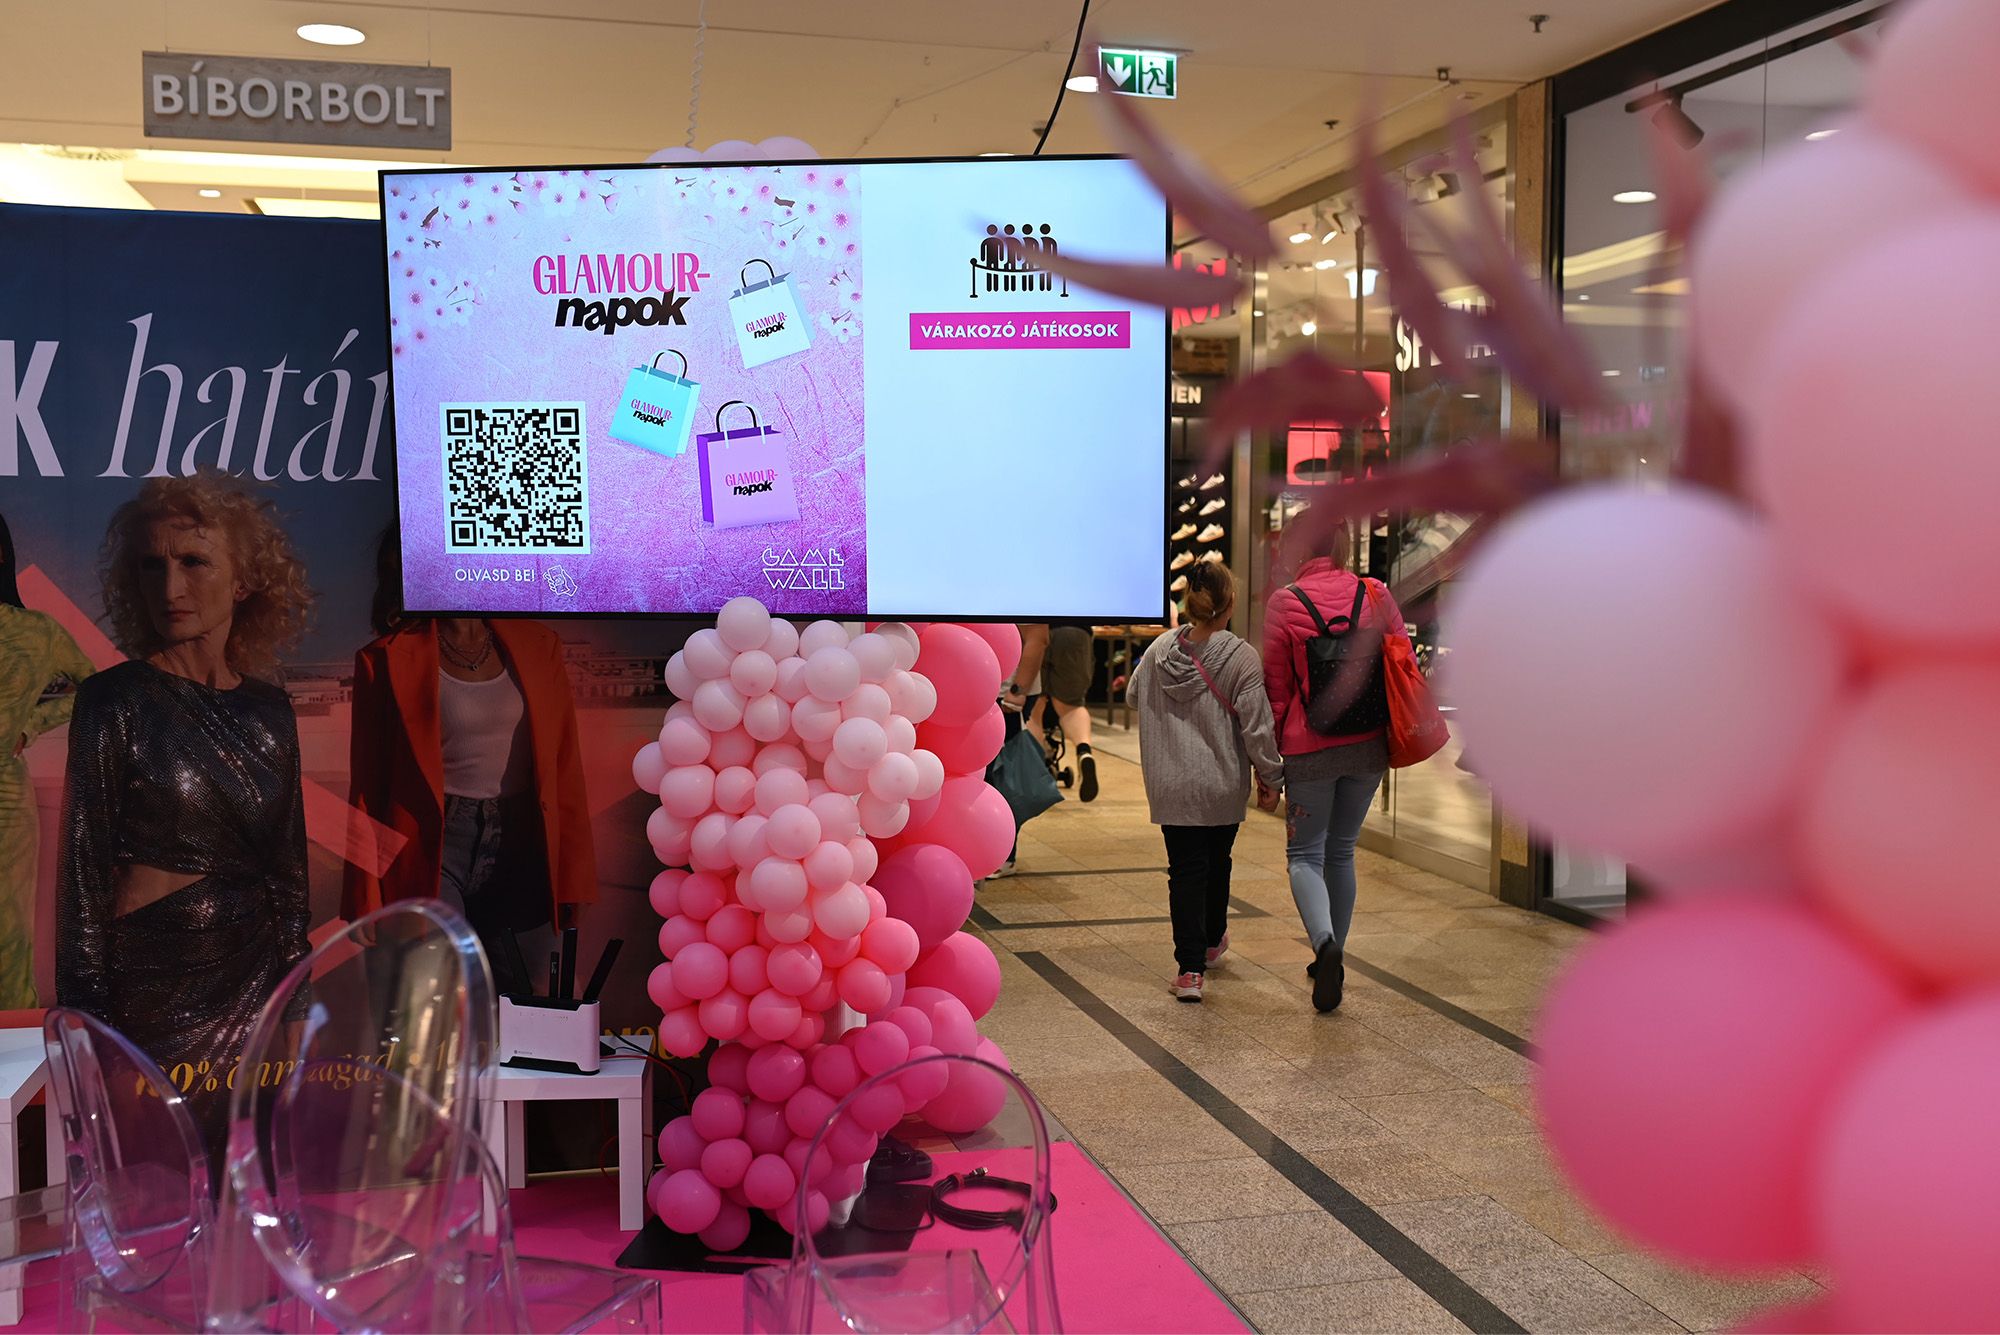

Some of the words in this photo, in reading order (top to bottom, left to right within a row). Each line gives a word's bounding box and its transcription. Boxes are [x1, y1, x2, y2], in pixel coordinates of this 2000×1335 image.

[152, 61, 445, 127] BÍBORBOLT
[532, 252, 711, 295] GLAMOUR-
[554, 287, 691, 335] napok
[745, 311, 788, 333] GLAMOUR-
[753, 321, 785, 339] napok
[920, 321, 1016, 338] VÁRAKOZÓ
[1021, 320, 1119, 337] JÁTÉKOSOK
[1172, 386, 1202, 404] EN
[632, 410, 667, 427] napok
[725, 468, 779, 487] GLAMOUR-
[733, 480, 773, 496] napok
[762, 548, 845, 566] GAME
[455, 569, 510, 581] OLVASD
[515, 569, 535, 581] BE!
[762, 568, 845, 589] WALL
